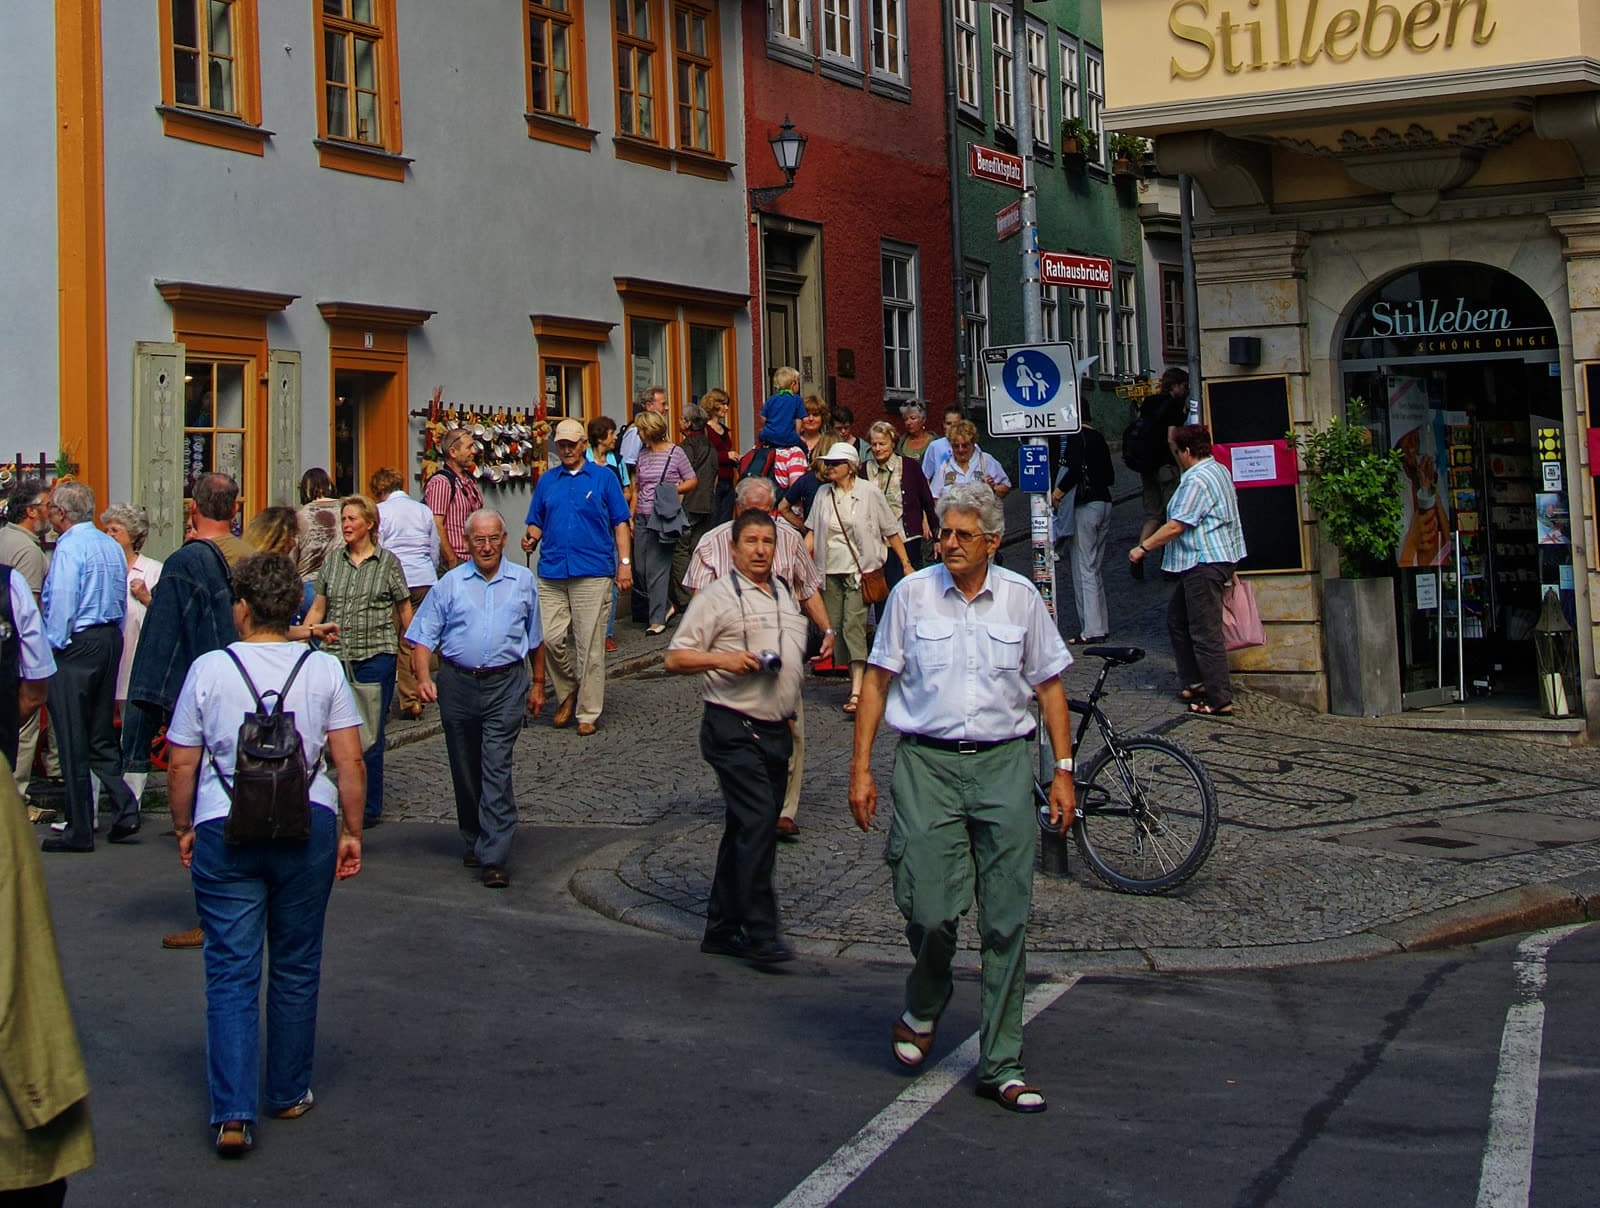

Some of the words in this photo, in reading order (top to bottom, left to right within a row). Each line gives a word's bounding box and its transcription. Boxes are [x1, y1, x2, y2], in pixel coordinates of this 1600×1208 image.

[977, 153, 1021, 182] Benediktsplatz
[1046, 260, 1109, 282] Rathausbrücke
[1372, 298, 1511, 337] Stilleben
[1418, 339, 1481, 352] SCHÖNE
[1495, 336, 1547, 348] DINGE
[1023, 413, 1056, 428] ONE
[1026, 451, 1034, 462] S
